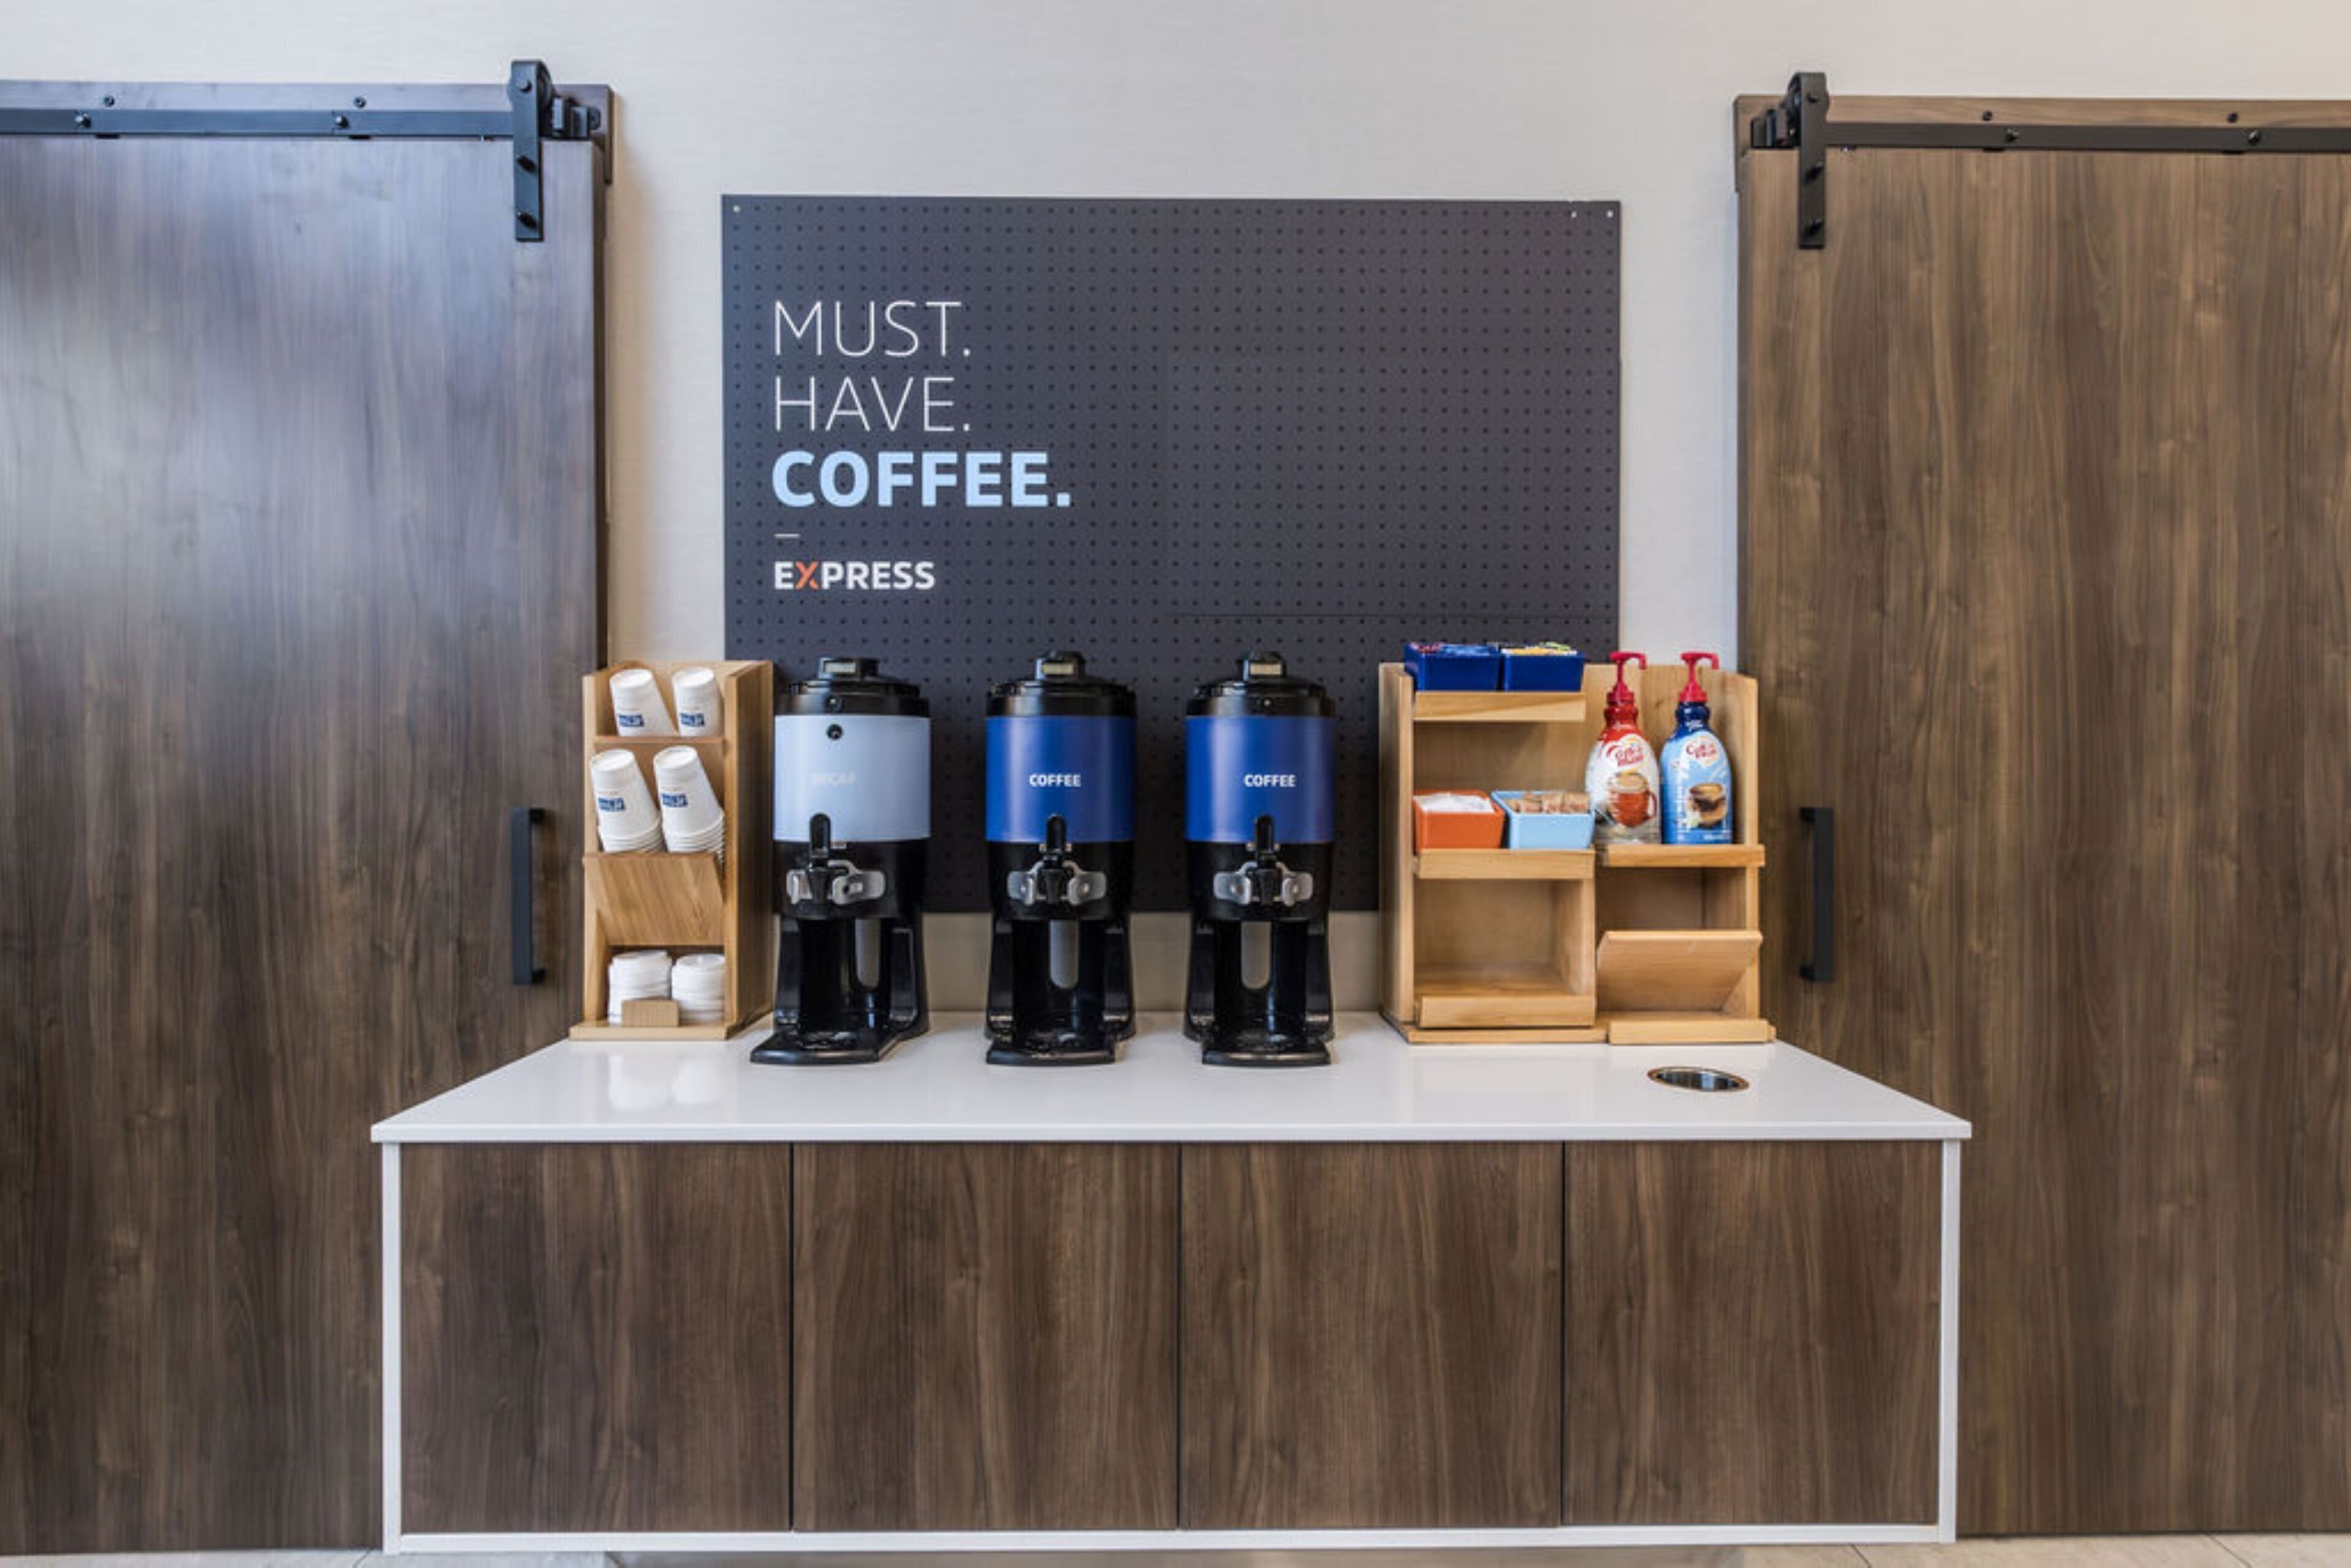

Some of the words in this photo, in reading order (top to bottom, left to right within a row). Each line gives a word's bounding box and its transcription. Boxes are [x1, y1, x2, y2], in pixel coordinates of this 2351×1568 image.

[774, 300, 971, 357] MUST.
[775, 376, 971, 432] HAVE.
[771, 449, 1071, 508] COFFEE.
[774, 561, 936, 590] EXPRESS
[1029, 773, 1081, 787] COFFEE
[1244, 774, 1296, 787] COFFEE
